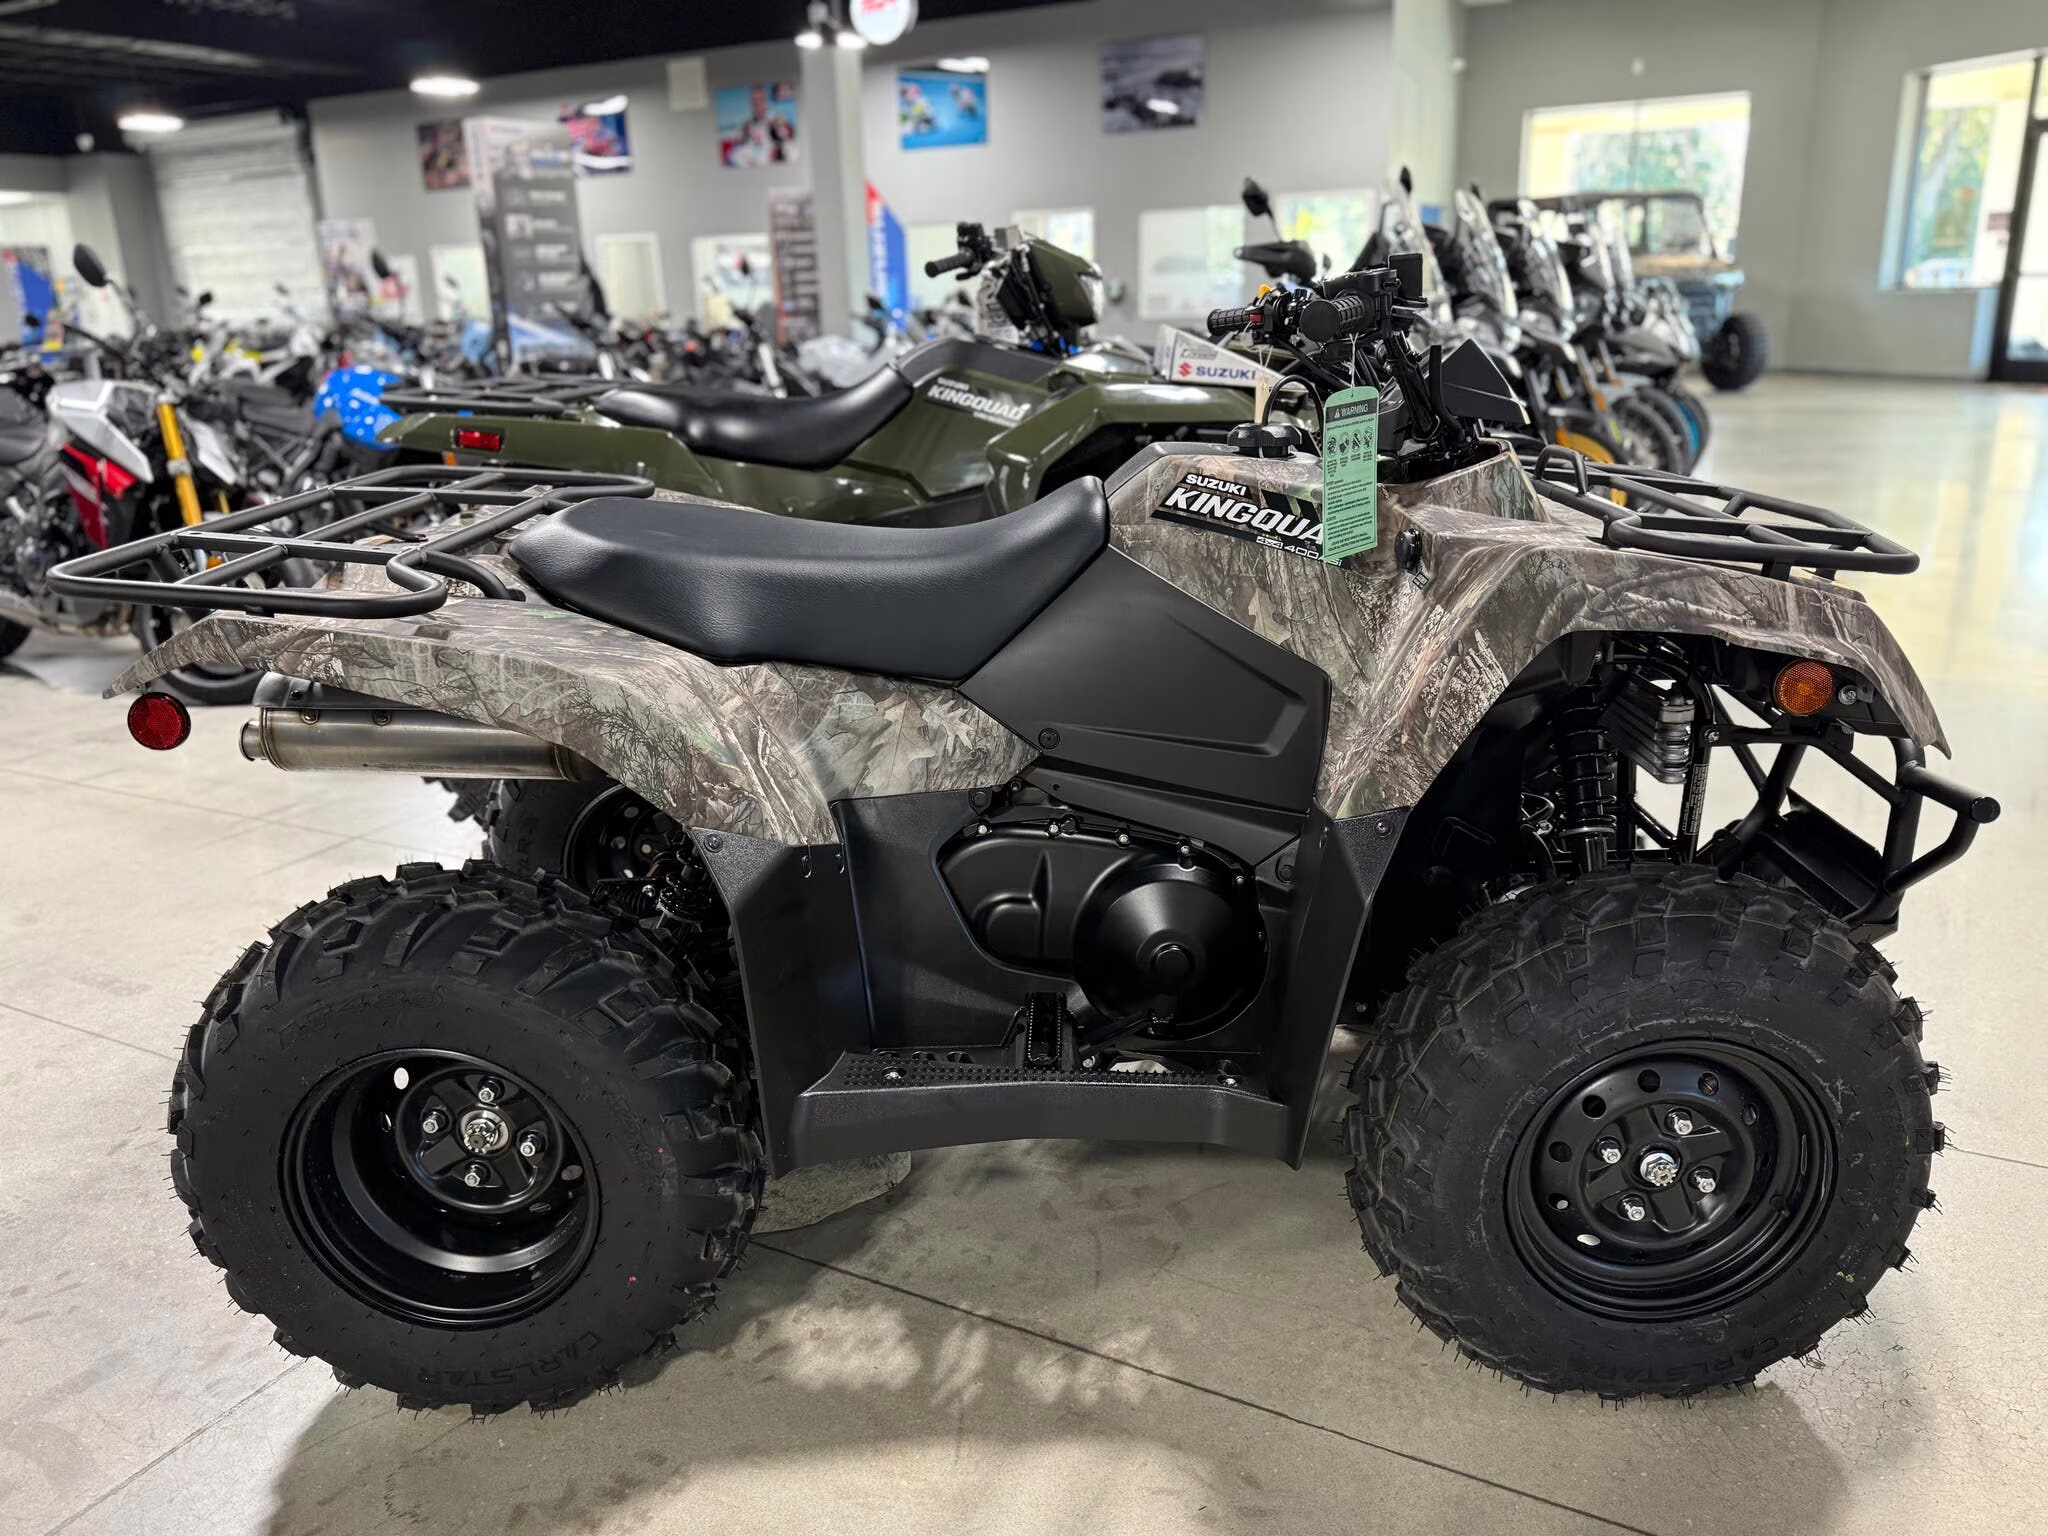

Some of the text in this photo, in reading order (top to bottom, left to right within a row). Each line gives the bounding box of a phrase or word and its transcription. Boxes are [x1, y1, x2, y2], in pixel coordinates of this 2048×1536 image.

[1196, 366, 1257, 380] SUZUKI
[1341, 403, 1369, 418] WARNING
[1185, 473, 1247, 497] SUZUKI
[1164, 487, 1324, 544] KINGQUA
[1284, 545, 1343, 567] 400Si
